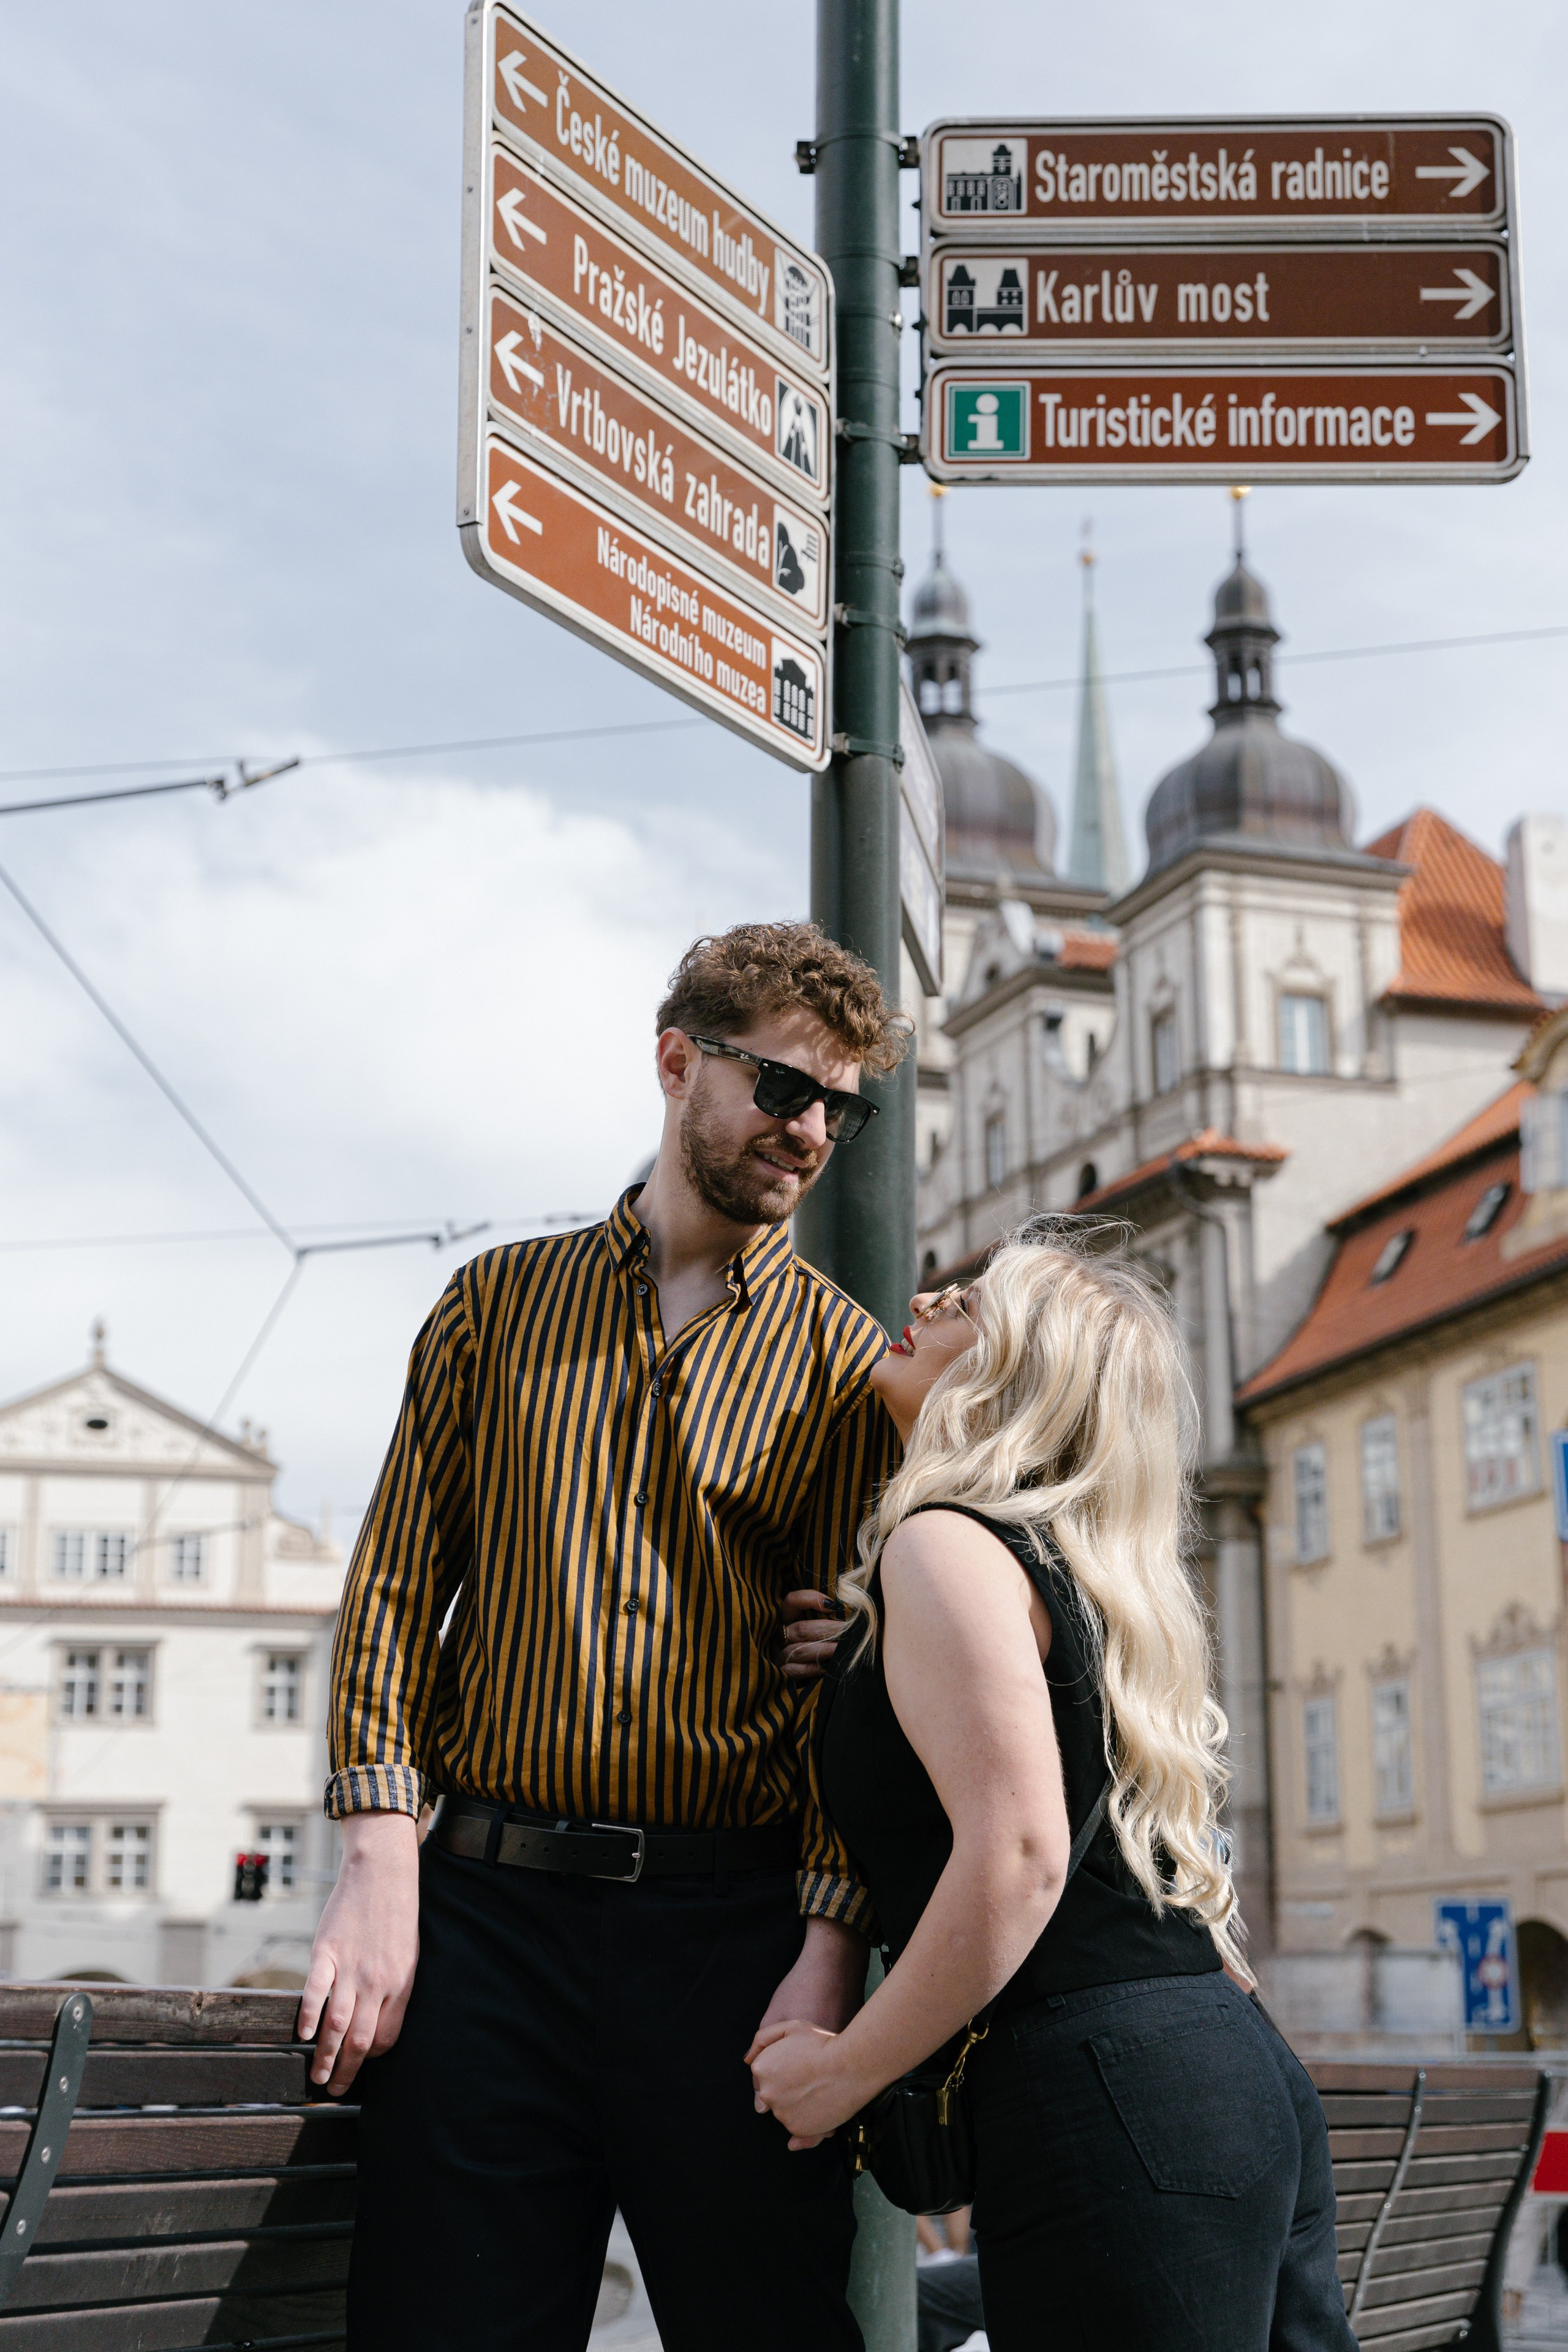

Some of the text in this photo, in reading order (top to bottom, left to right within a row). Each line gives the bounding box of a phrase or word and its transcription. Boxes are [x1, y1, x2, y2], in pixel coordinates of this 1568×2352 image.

[556, 69, 770, 317] České muzeum hudby
[1035, 147, 1389, 203] Staroměstská radnice
[574, 233, 772, 437] Pražské Jezulátko
[1037, 270, 1270, 323] Karlův most
[557, 362, 770, 570] Vrtbovská zahrada
[1038, 392, 1415, 448] Turistické informace
[598, 526, 766, 671] Národopisné muzeum
[630, 594, 766, 715] Národního muzea
